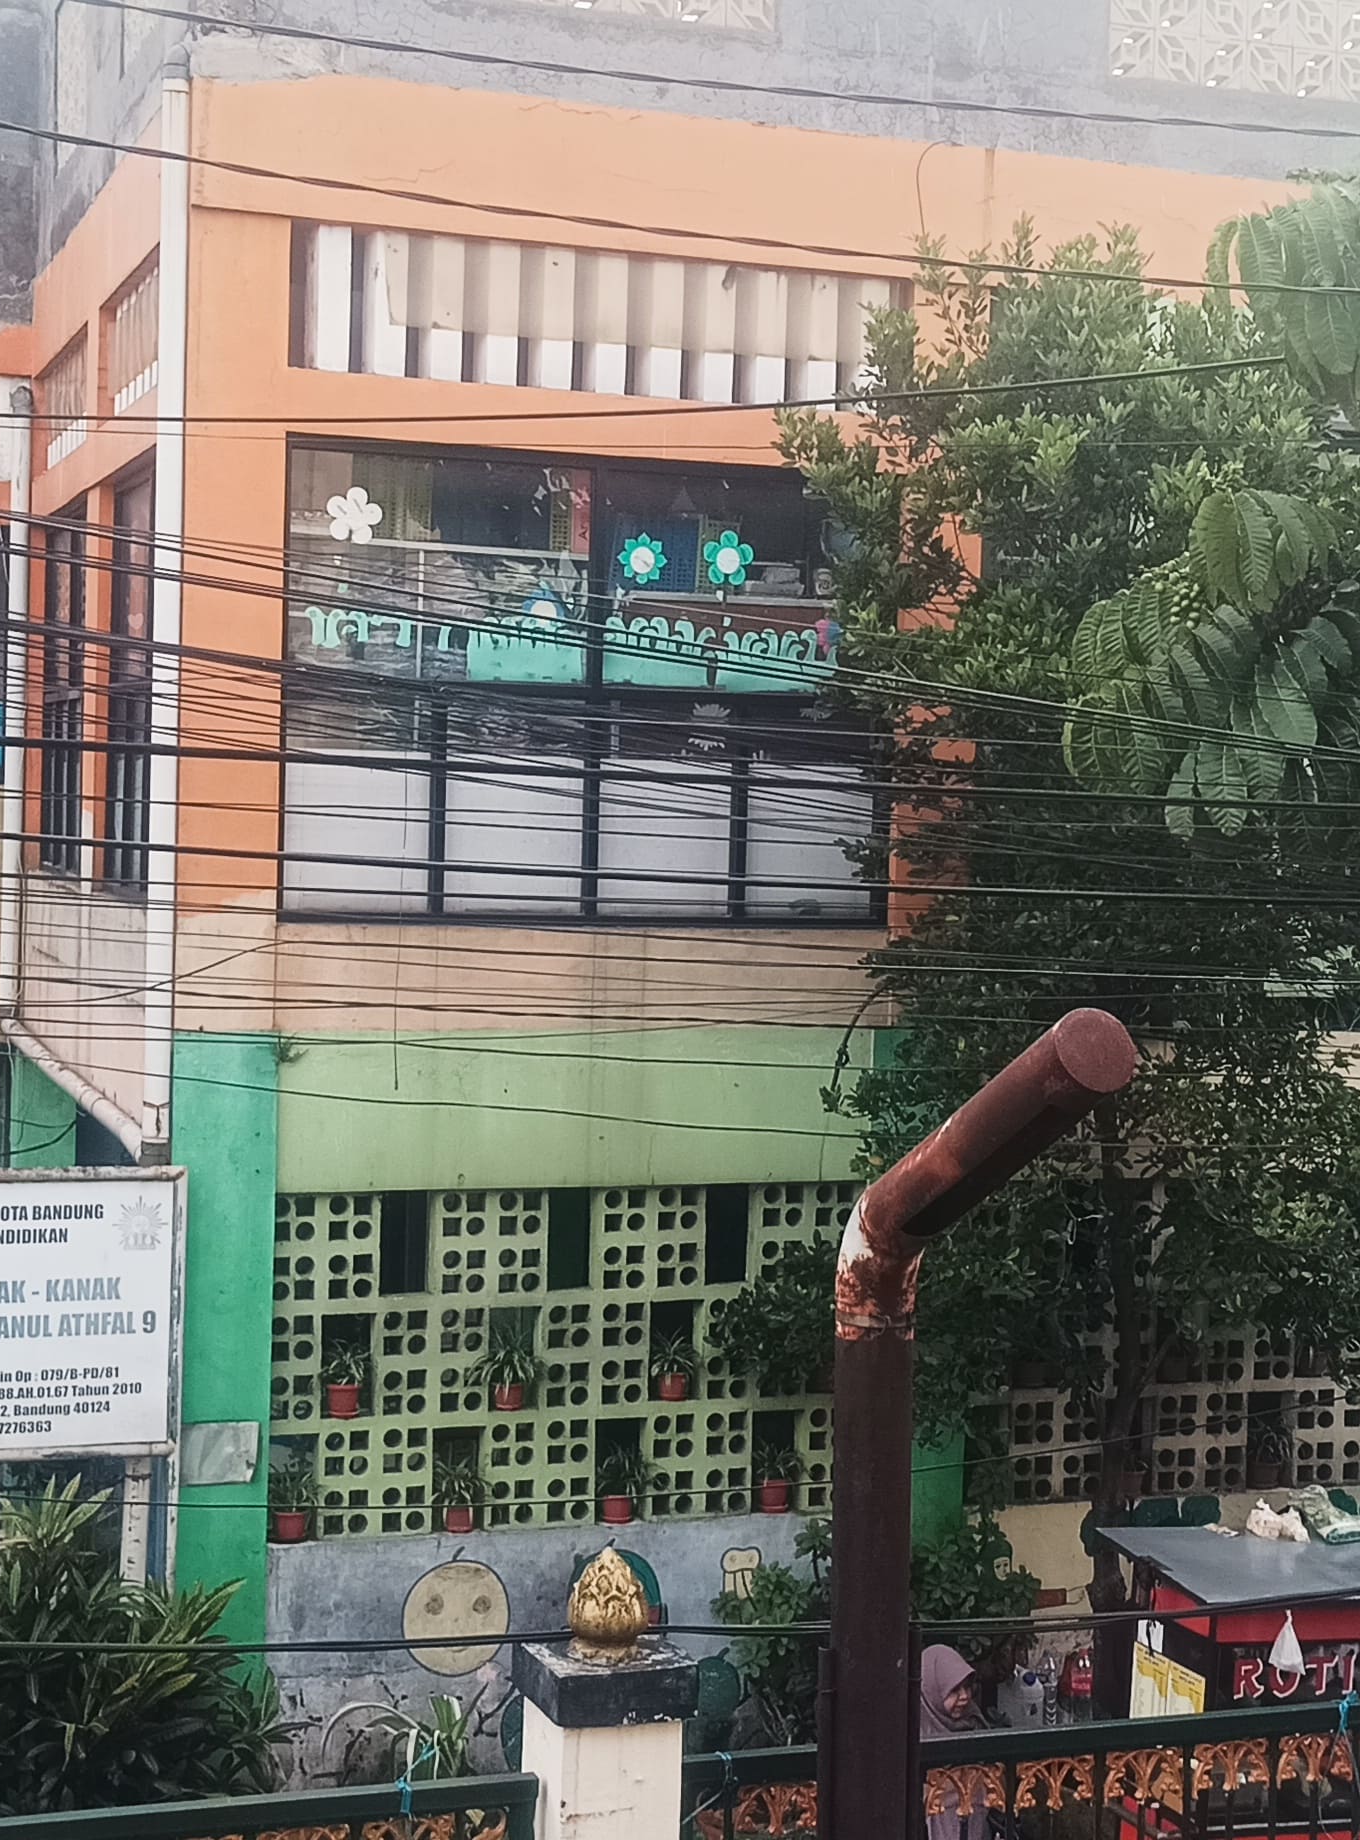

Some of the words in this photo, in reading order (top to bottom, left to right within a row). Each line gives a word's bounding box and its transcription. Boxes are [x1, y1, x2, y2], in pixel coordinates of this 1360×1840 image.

[32, 1203, 104, 1220] BANDUNG
[46, 1277, 121, 1302] KANAK
[57, 1311, 136, 1337] ATHFAL
[142, 1310, 156, 1334] 9
[15, 1370, 31, 1383] Op
[72, 1384, 109, 1397] Tahun
[112, 1382, 142, 1395] 2010
[13, 1403, 70, 1416] Bandung
[73, 1401, 110, 1413] 40124
[1233, 1653, 1357, 1699] ROTI
